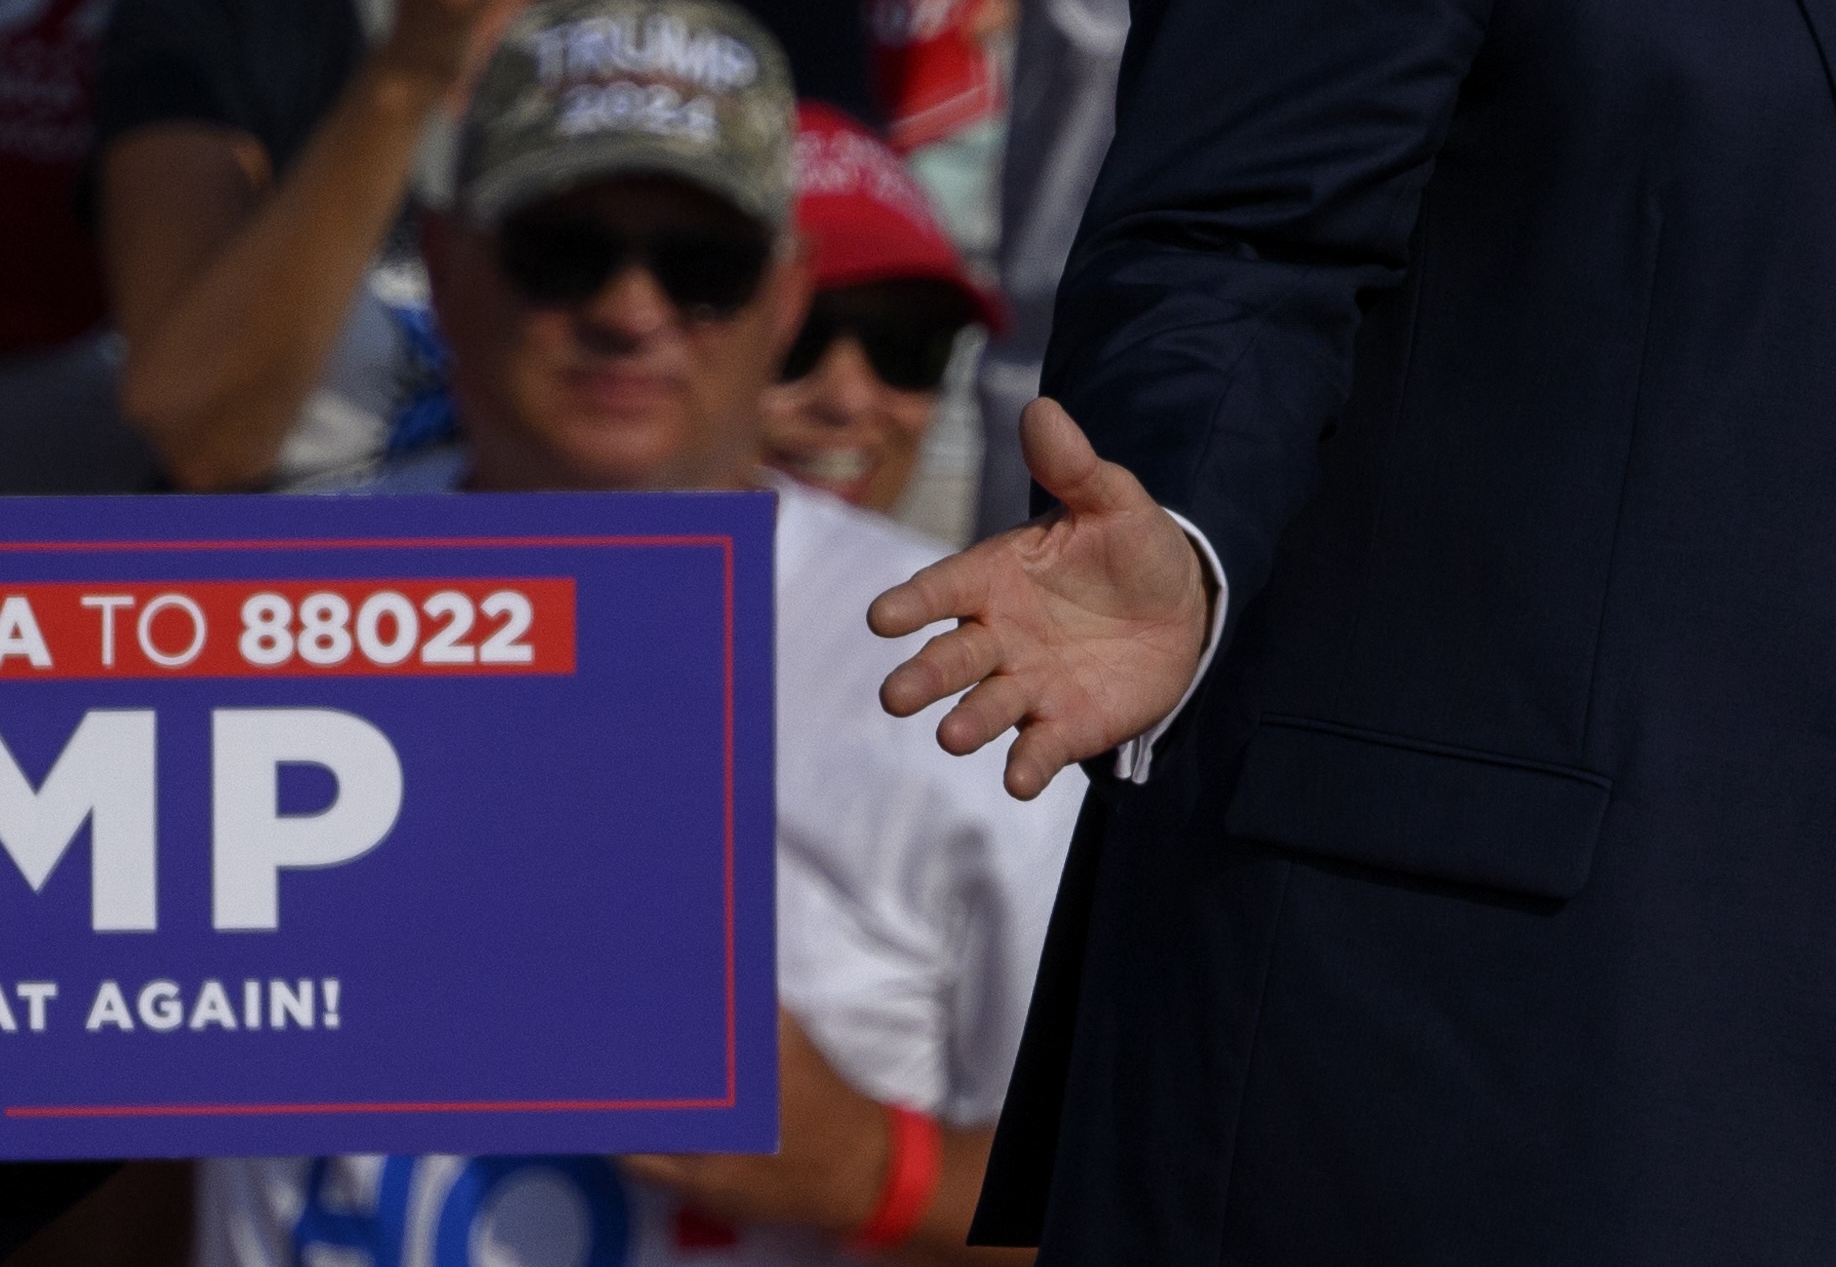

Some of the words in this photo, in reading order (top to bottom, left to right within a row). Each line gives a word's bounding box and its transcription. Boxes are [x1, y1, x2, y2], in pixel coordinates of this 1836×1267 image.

[533, 14, 759, 91] TRUMP
[80, 592, 207, 669] TO
[238, 589, 535, 666] 88022
[86, 978, 341, 1030] AGAIN!
